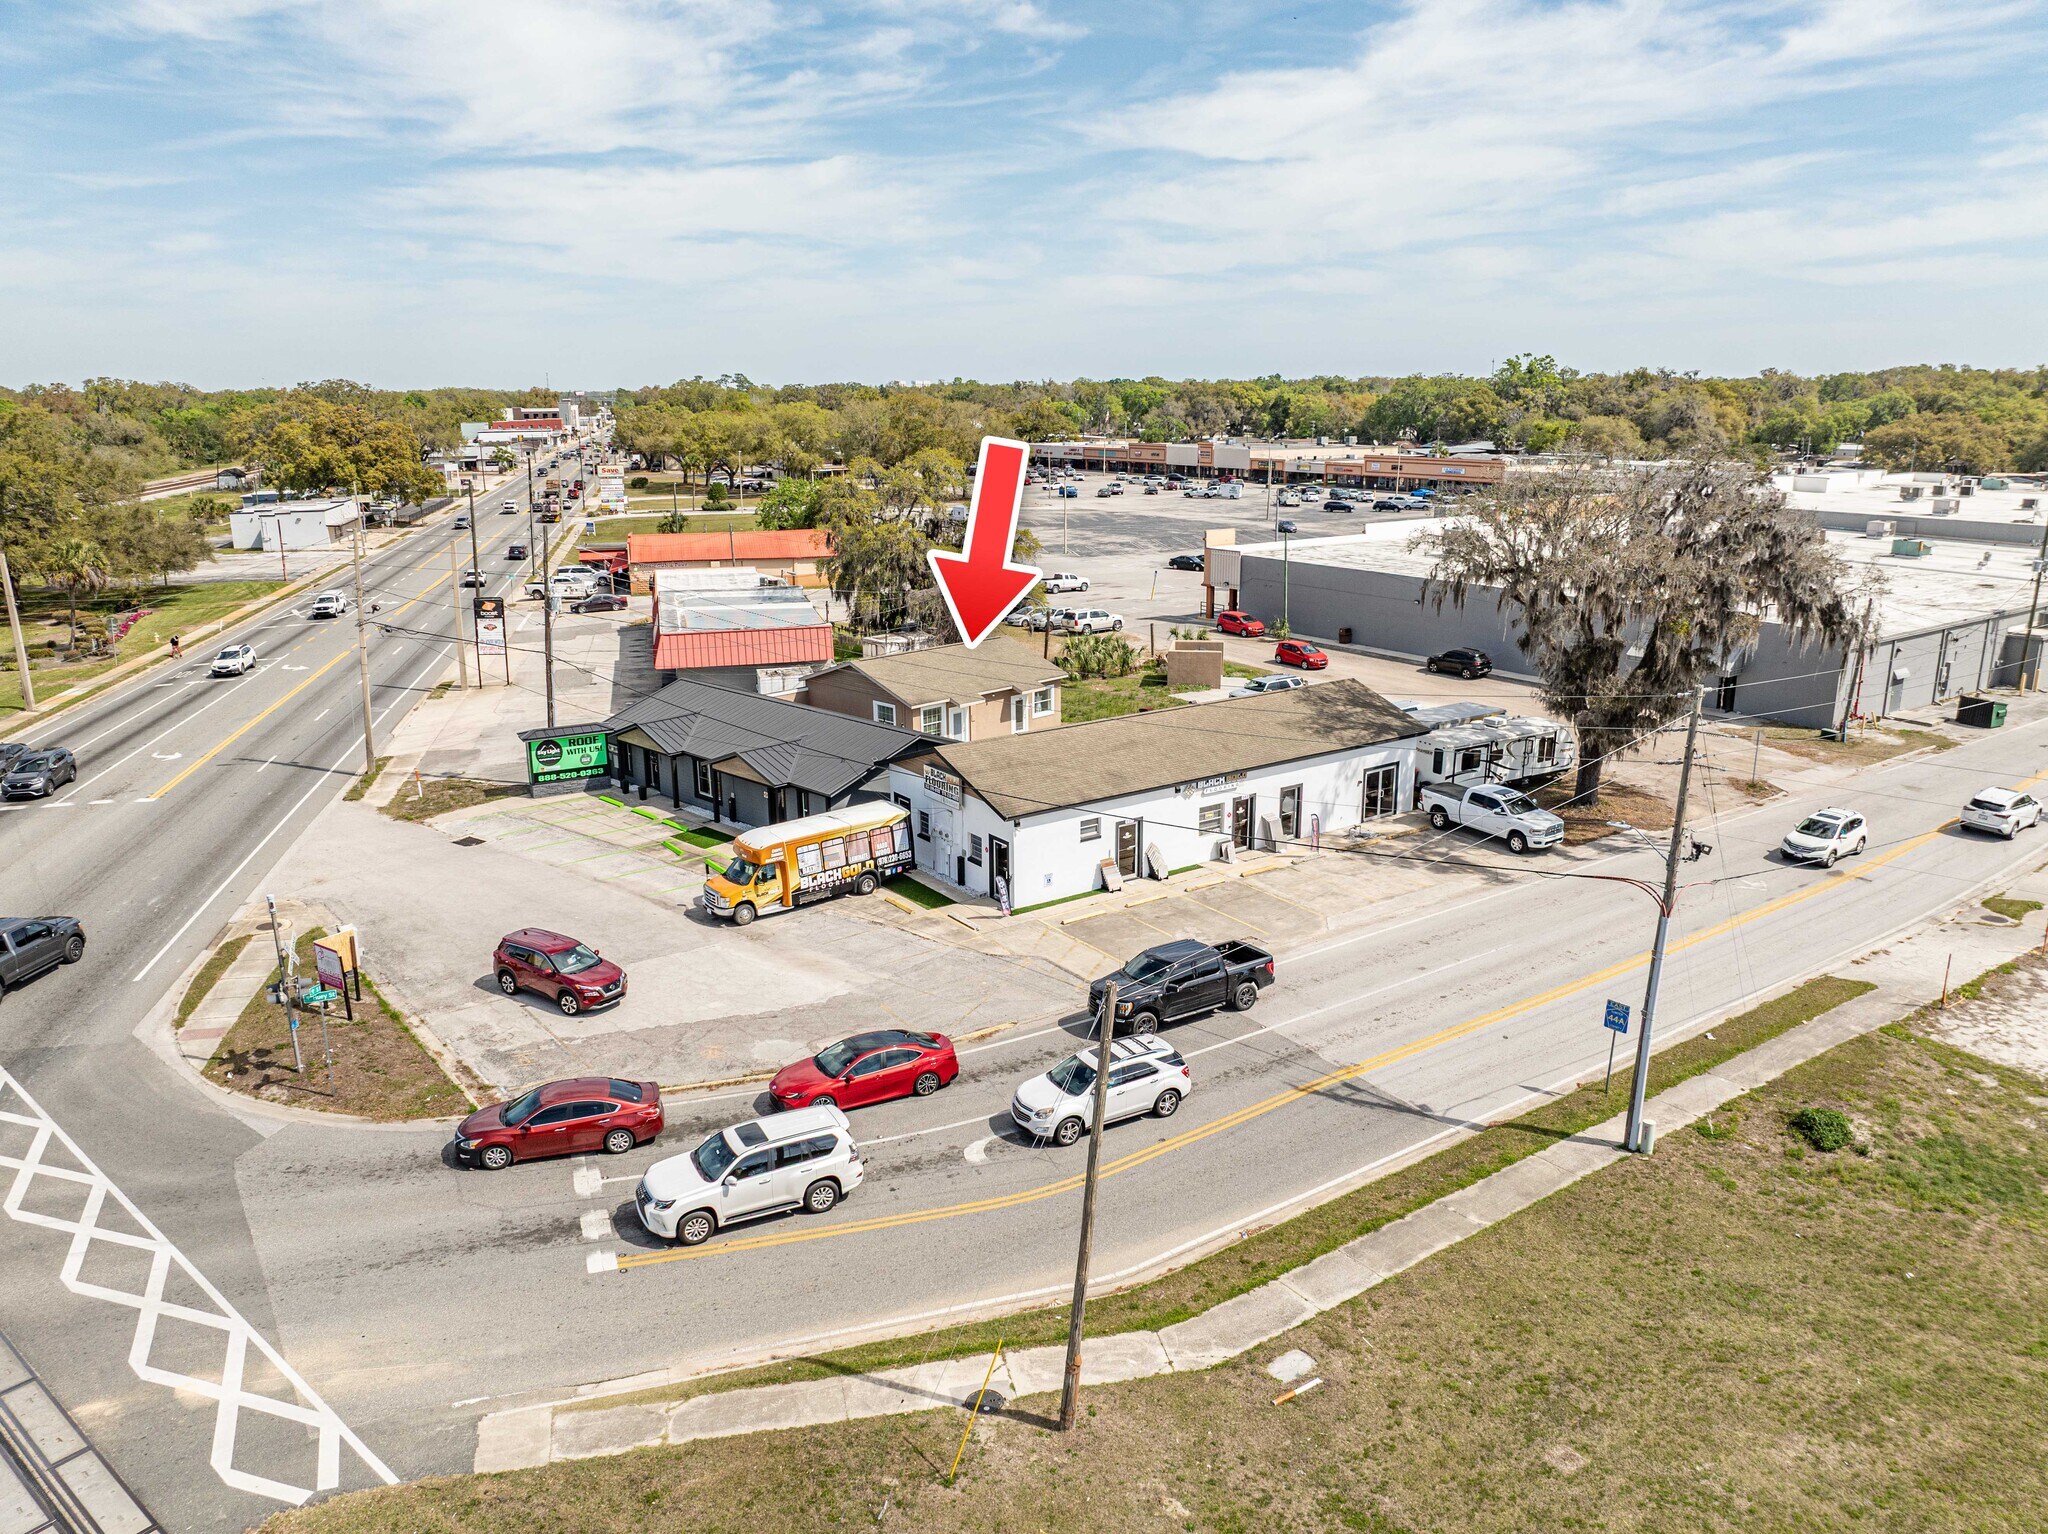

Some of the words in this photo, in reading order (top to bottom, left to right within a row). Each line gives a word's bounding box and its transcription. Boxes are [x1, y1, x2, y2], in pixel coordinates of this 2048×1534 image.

[568, 736, 599, 747] ROOF
[566, 747, 586, 755] WITH
[925, 775, 959, 796] FLOORING
[1608, 1014, 1625, 1026] 44A
